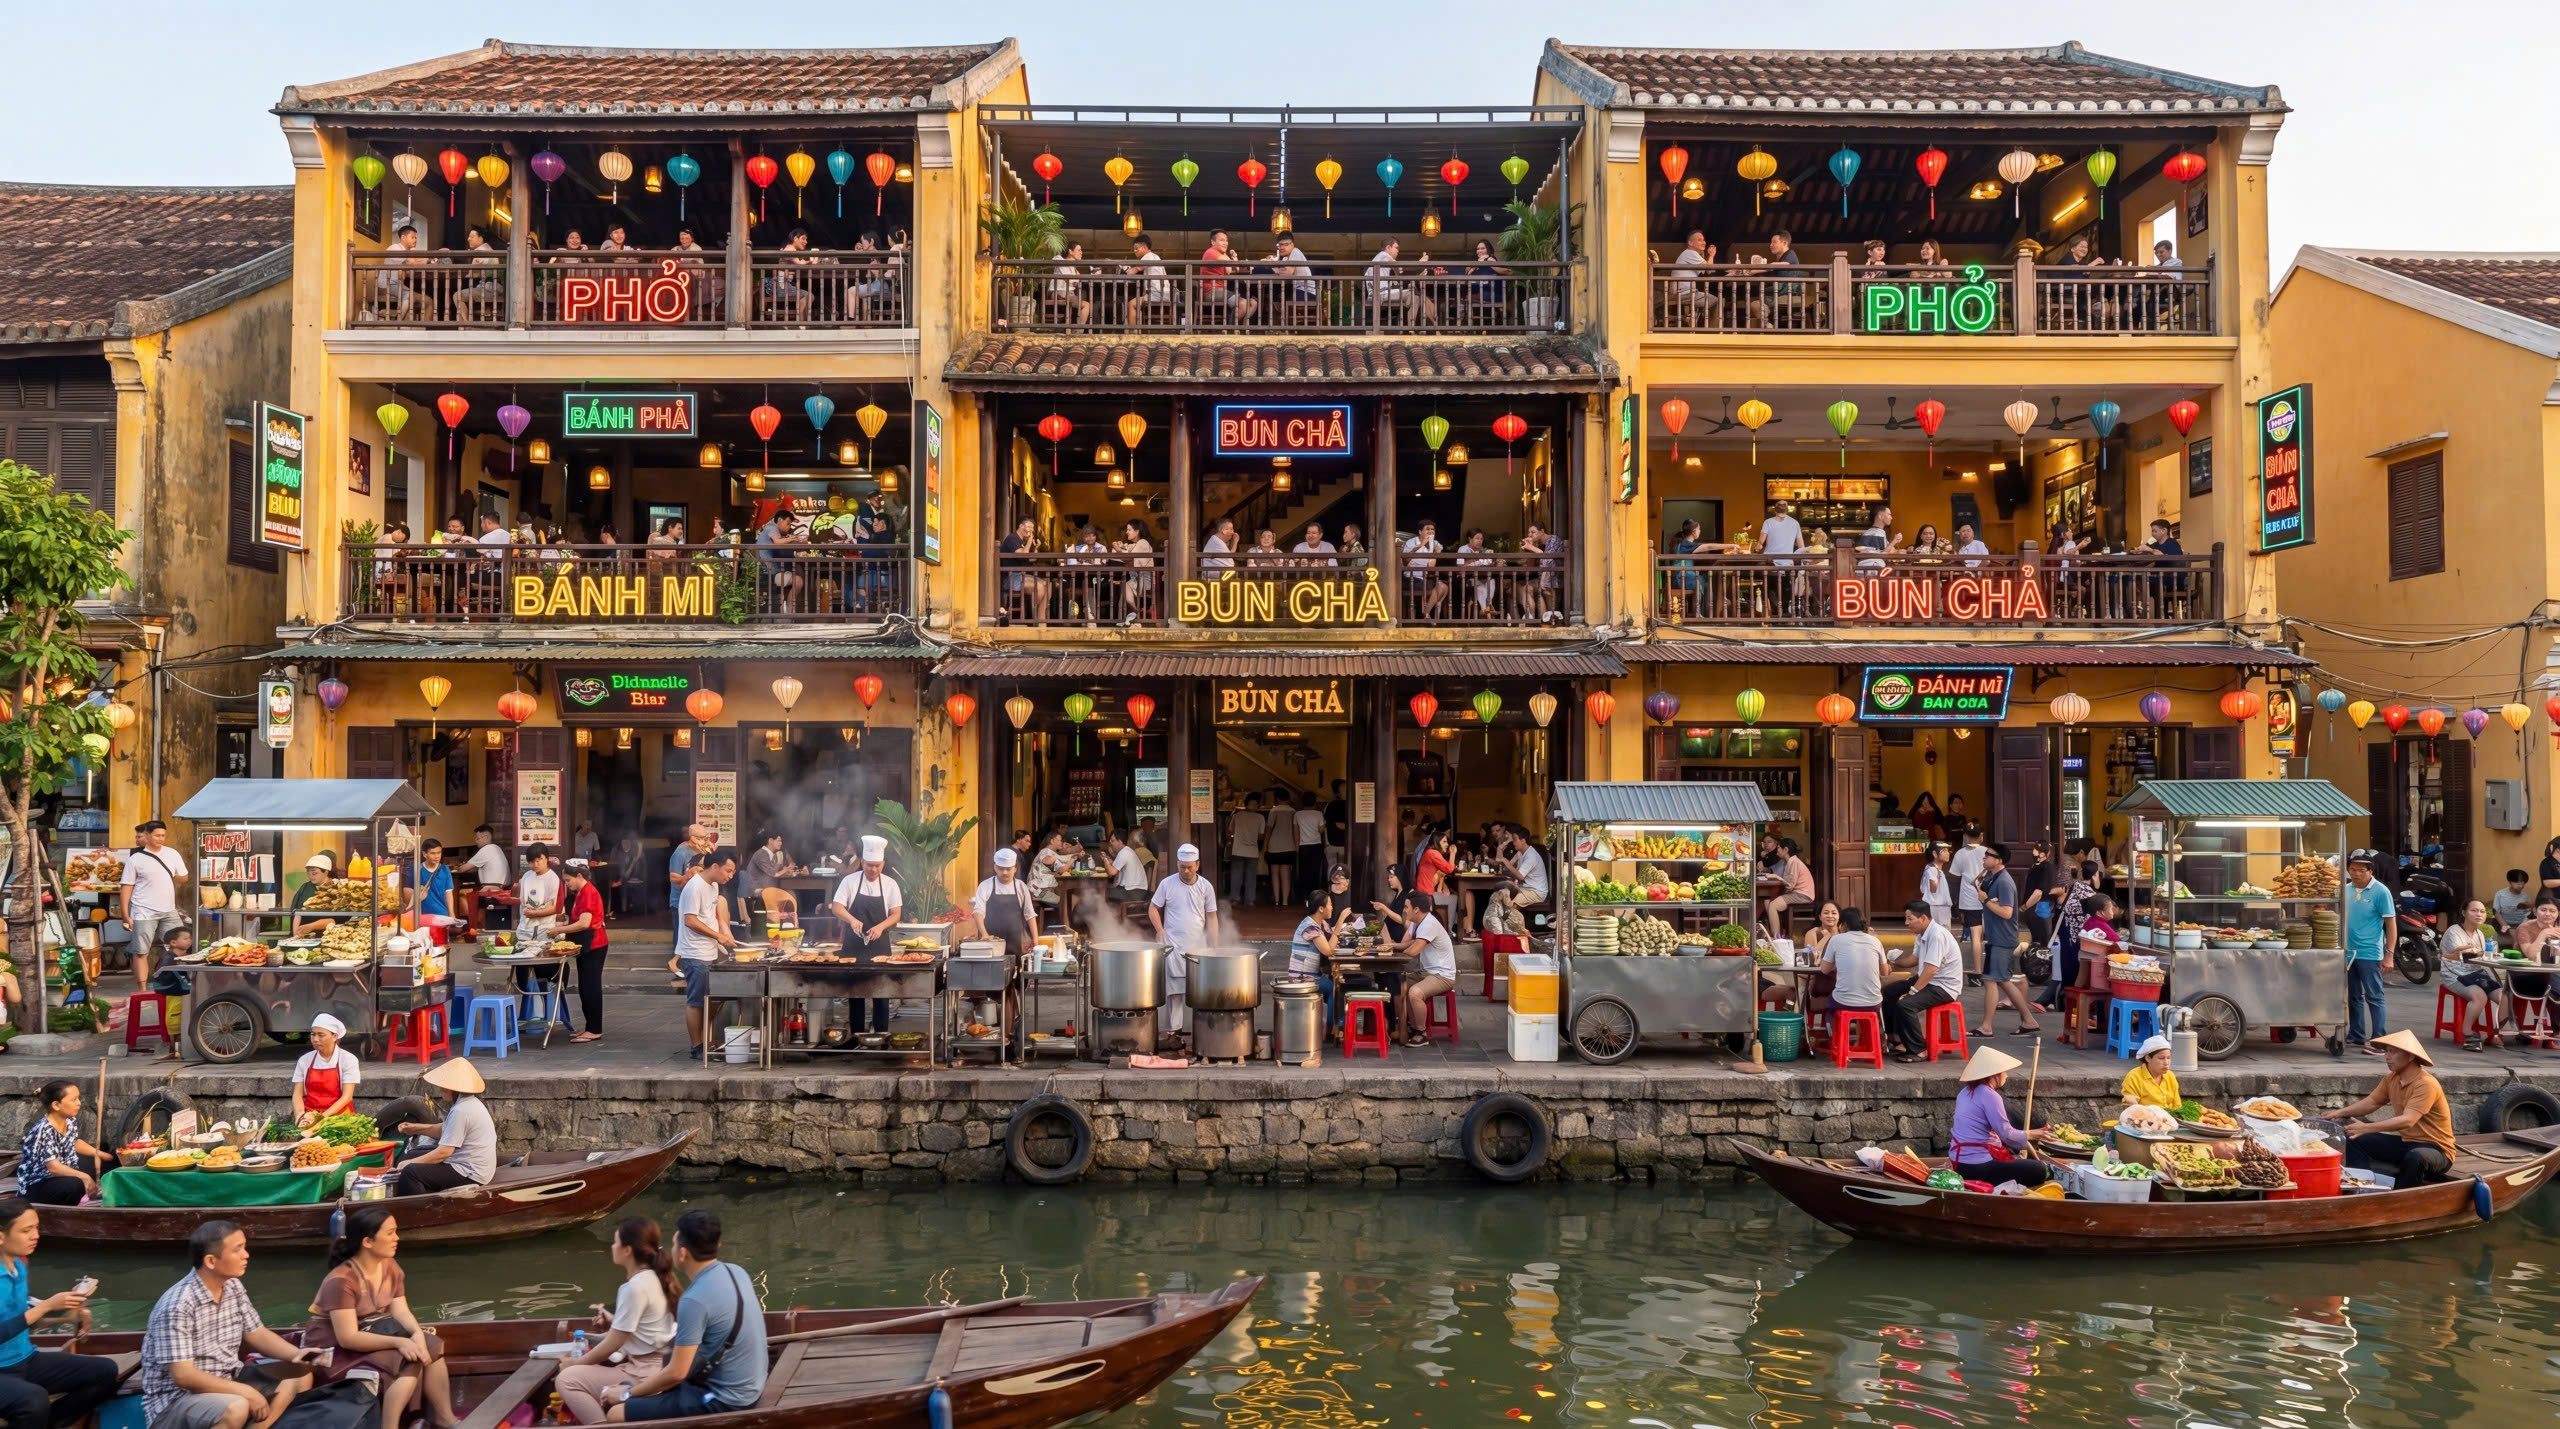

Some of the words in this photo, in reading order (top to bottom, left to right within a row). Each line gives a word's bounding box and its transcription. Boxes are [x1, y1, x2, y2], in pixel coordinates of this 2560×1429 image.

[564, 259, 690, 322] PHỞ
[1867, 264, 1996, 332] PHỞ
[570, 399, 634, 429] BÁNH
[1221, 410, 1278, 447] BÚN
[1287, 410, 1346, 447] CHẢ
[514, 563, 645, 616] BÁNH
[662, 563, 715, 616] MÌ
[1177, 570, 1275, 622] BÚN
[1289, 567, 1390, 622] CHẢ
[1836, 567, 1933, 619] BÚN
[1948, 565, 2048, 619] CHẢ
